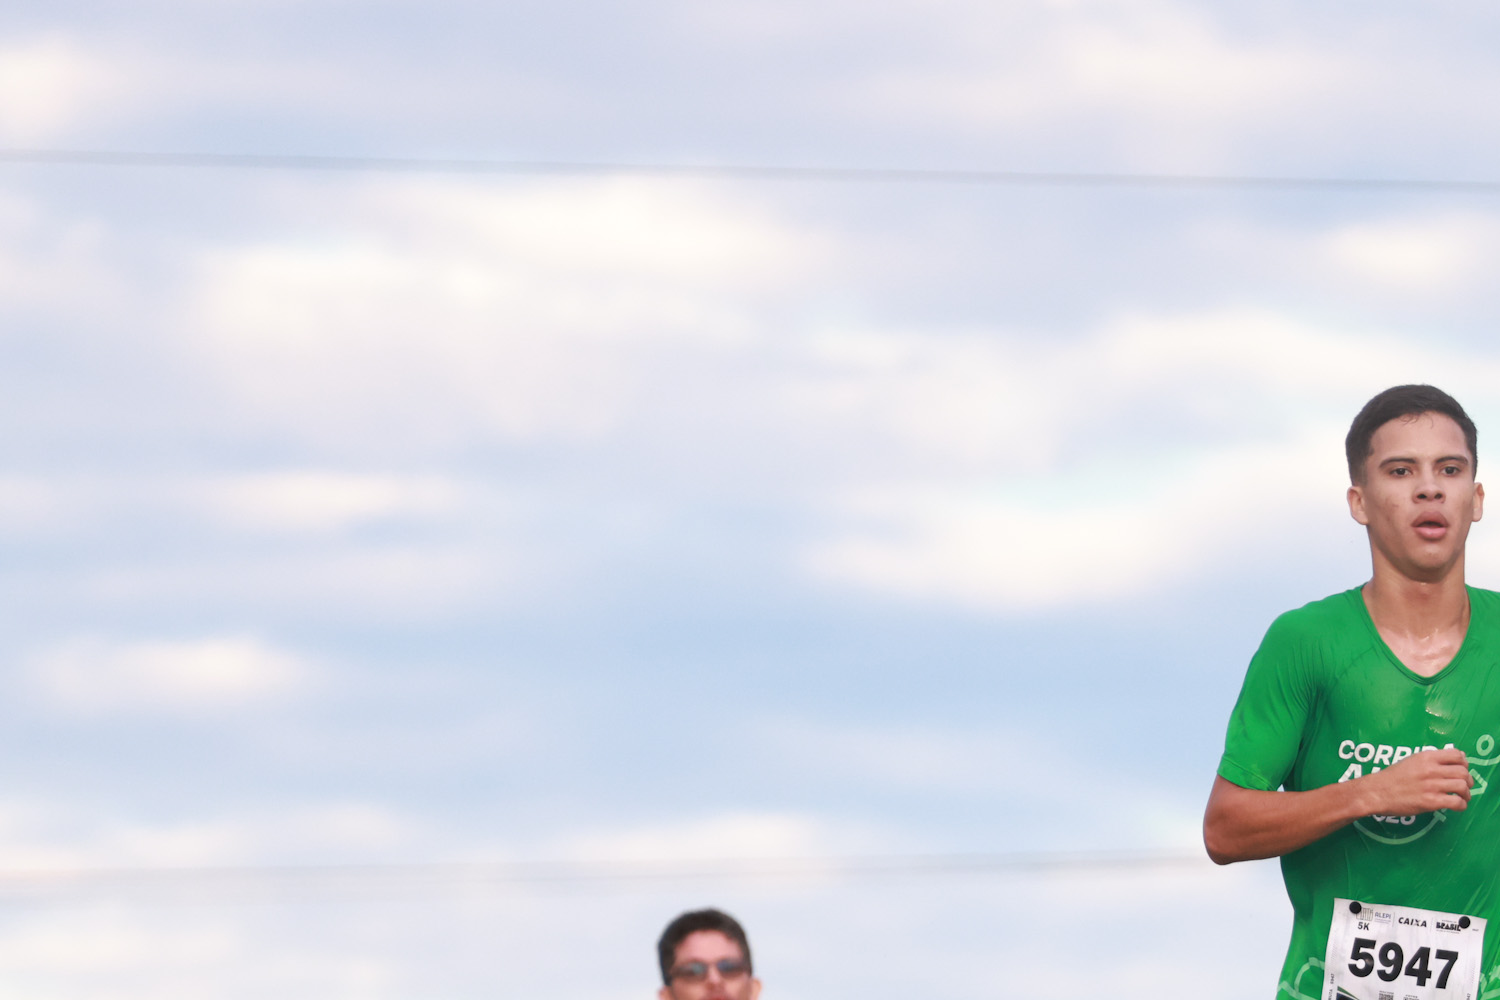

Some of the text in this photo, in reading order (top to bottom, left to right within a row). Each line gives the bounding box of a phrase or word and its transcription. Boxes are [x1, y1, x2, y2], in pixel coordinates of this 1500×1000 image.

[1338, 739, 1455, 766] CORR
[1357, 921, 1370, 931] 5K
[1398, 916, 1427, 928] CAIXA
[1348, 937, 1459, 989] 5947
